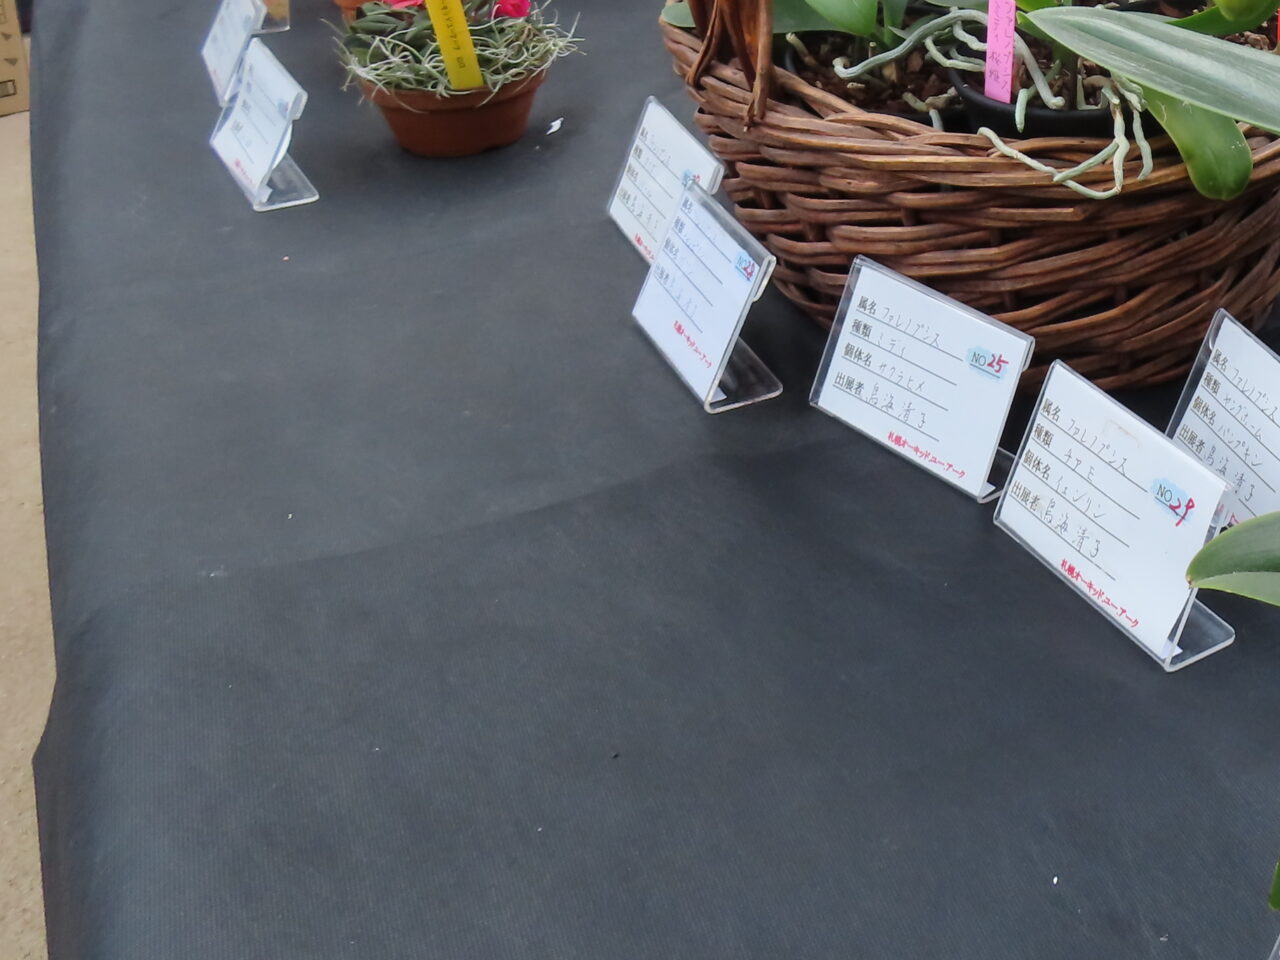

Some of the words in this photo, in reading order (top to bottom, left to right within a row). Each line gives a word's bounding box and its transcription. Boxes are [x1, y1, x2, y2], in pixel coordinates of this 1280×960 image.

[852, 318, 870, 339] 種類
[857, 295, 877, 316] 属名
[883, 307, 941, 348] ファレノプシス
[843, 343, 872, 368] 個体名
[1212, 348, 1228, 371] 属名
[834, 372, 865, 397] 出展者
[1203, 371, 1222, 394] 種類
[1193, 395, 1217, 426] 個体名
[1033, 423, 1055, 448] 種類
[1041, 399, 1060, 422] 属名
[1069, 417, 1129, 477] ファレノプシス
[1180, 424, 1206, 452] 出展者
[1023, 449, 1051, 480] 個体名
[1011, 483, 1041, 513] 出展者
